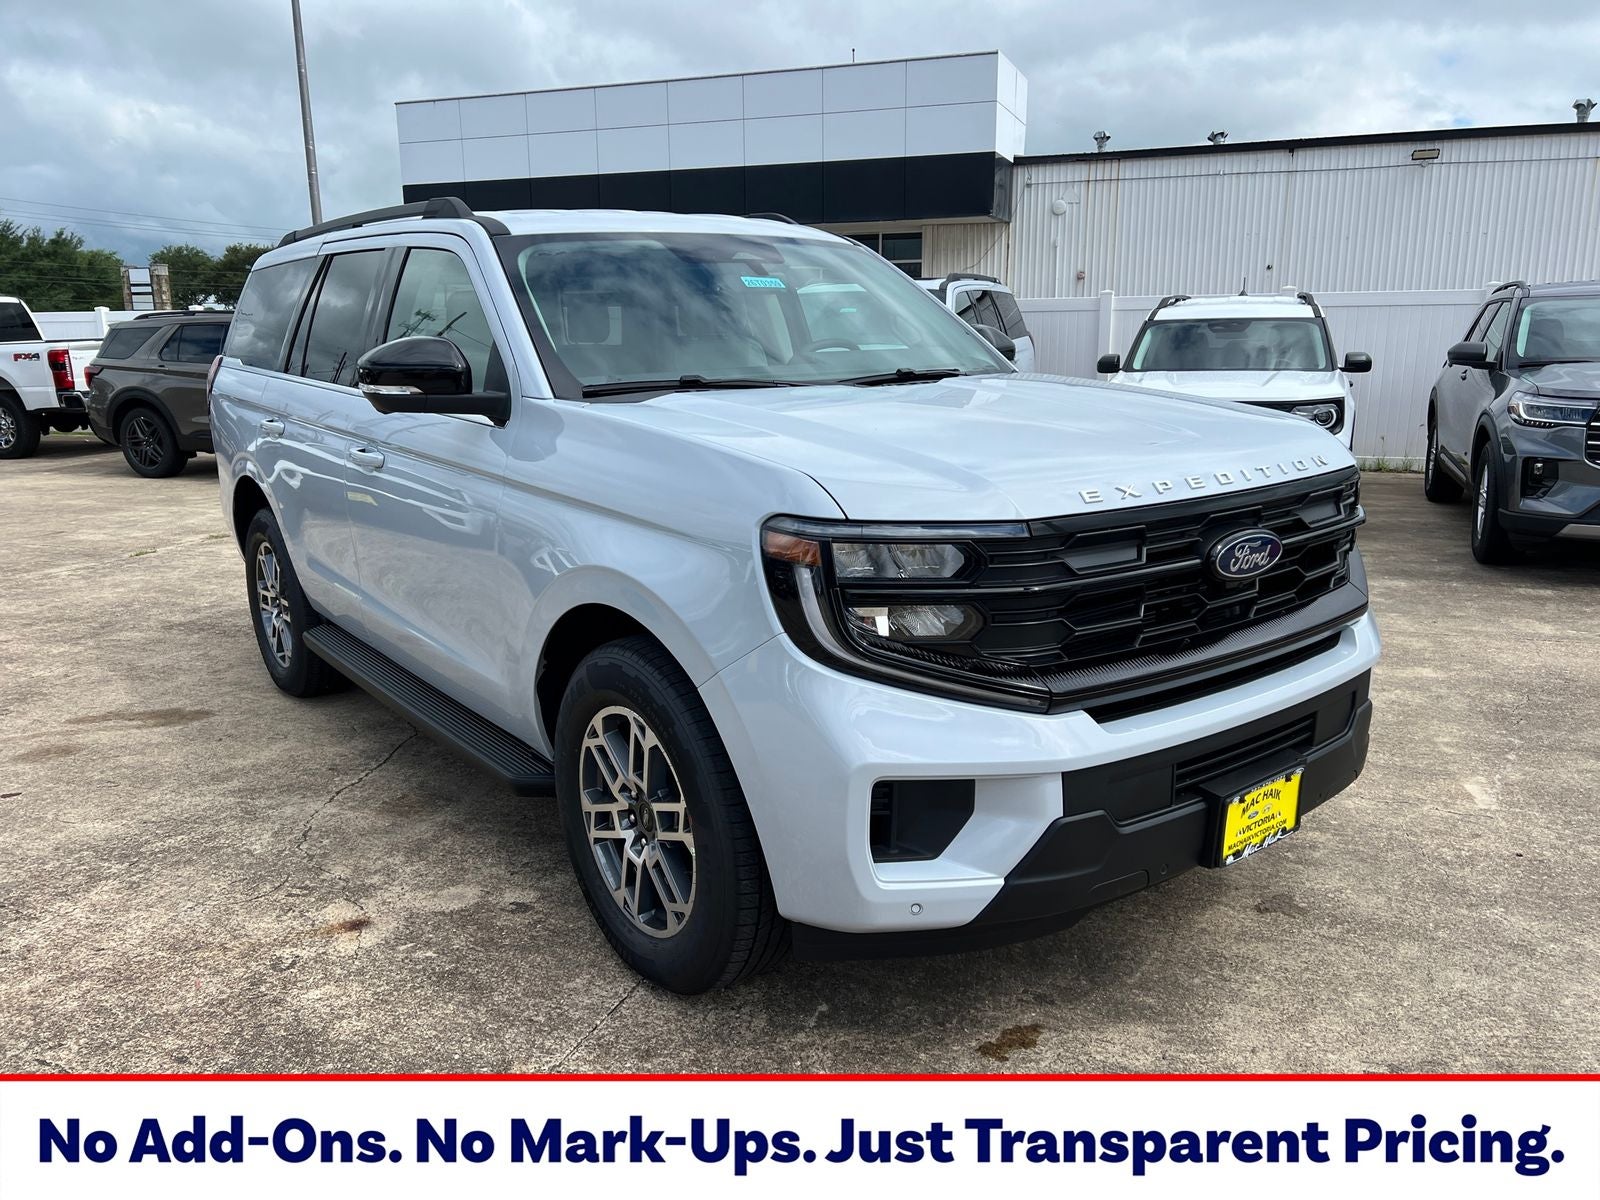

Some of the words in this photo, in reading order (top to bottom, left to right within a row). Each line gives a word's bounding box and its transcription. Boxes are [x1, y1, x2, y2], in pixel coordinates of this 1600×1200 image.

[14, 353, 40, 361] FX4
[1079, 455, 1328, 504] EXPEDITION
[1229, 541, 1270, 572] Ford
[1241, 793, 1262, 818] MAC
[1262, 788, 1281, 801] HAIK
[1228, 818, 1287, 850] MACHAIKVICTORIA.COM
[1242, 813, 1276, 835] VICTORIA
